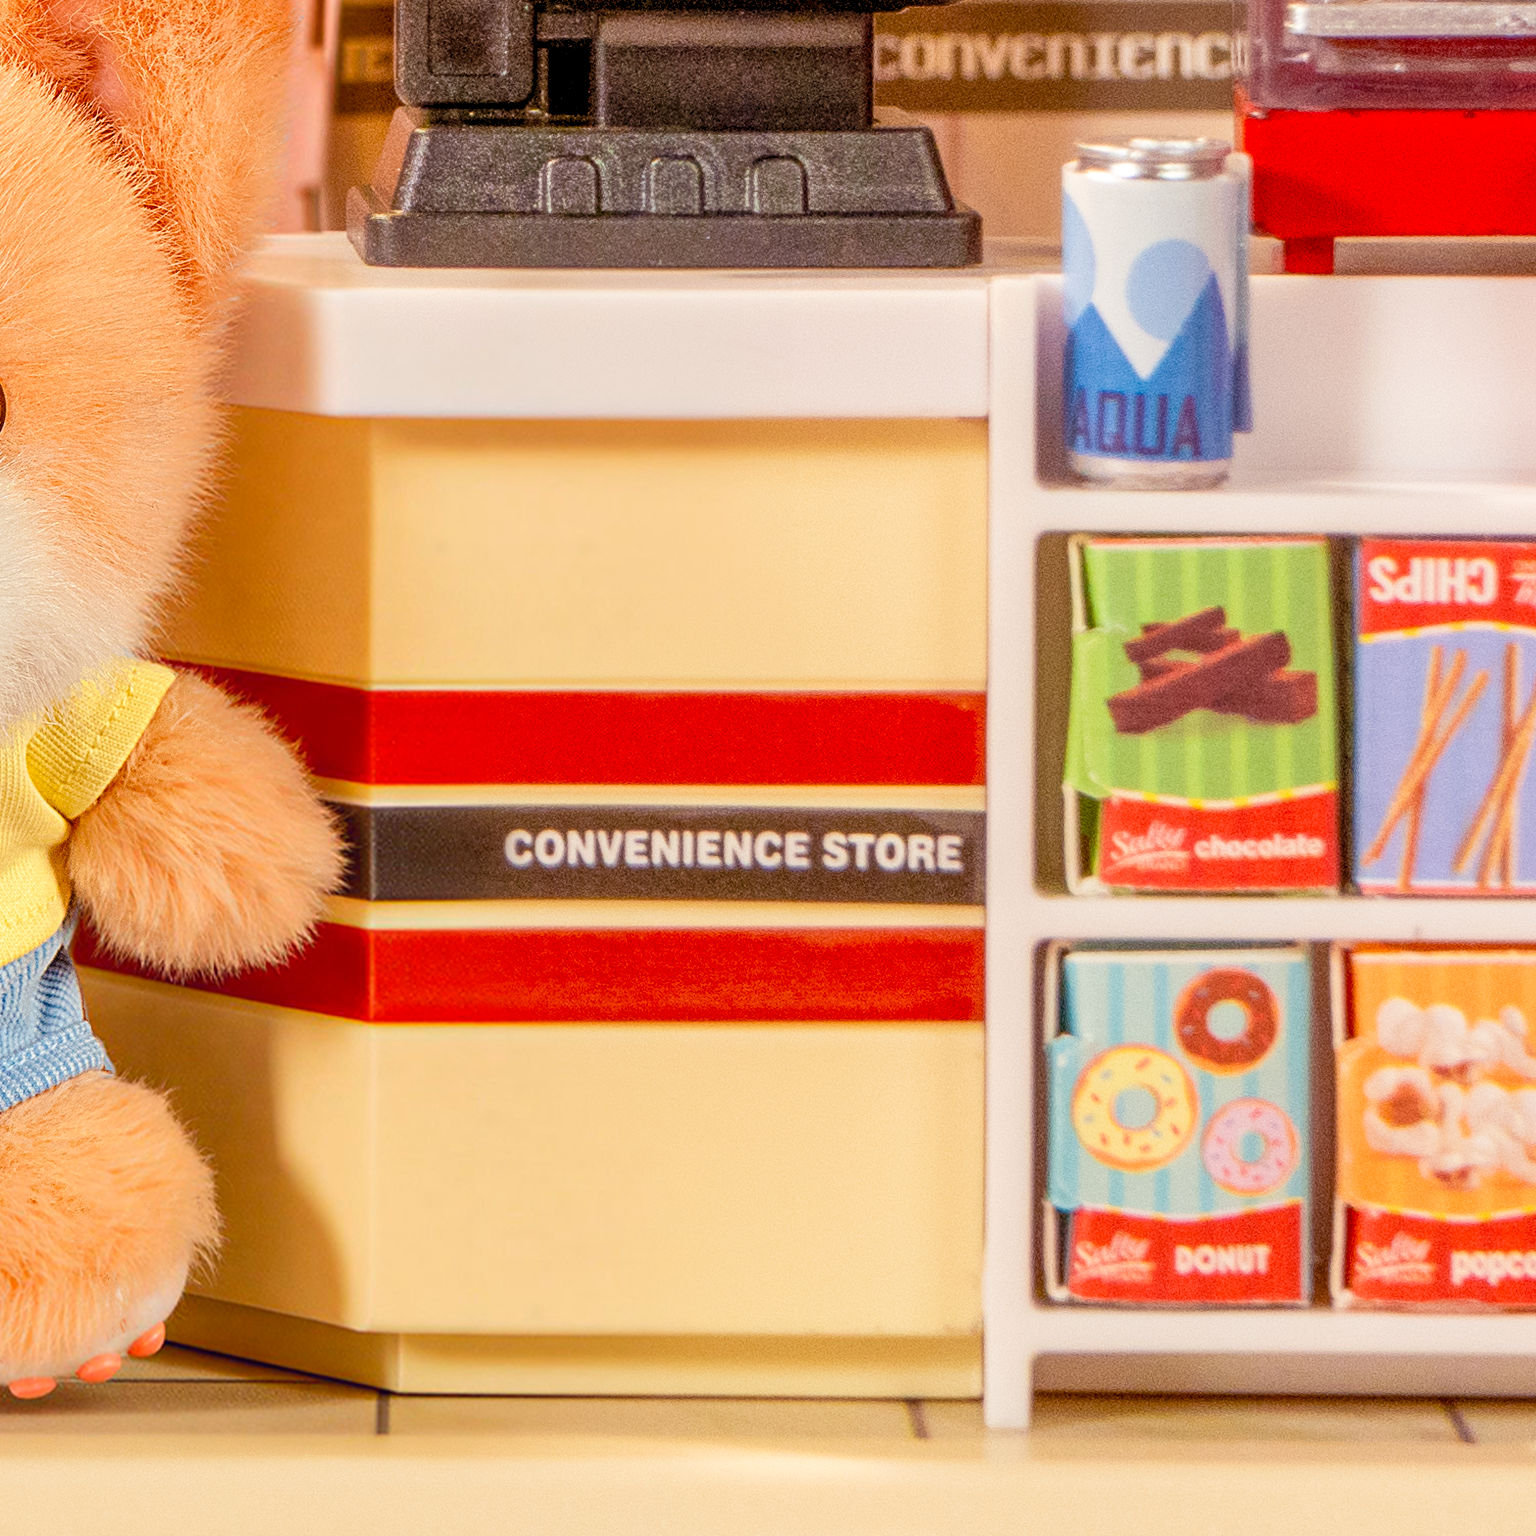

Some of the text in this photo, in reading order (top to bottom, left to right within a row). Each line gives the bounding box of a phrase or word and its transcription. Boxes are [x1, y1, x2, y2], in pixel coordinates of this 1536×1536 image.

[874, 32, 1242, 81] CONVENIENC
[1367, 555, 1500, 604] CHIPS
[504, 828, 964, 873] CONVENIENCE STORE
[1193, 833, 1326, 860] chocolate
[1174, 1244, 1272, 1276] DONUT
